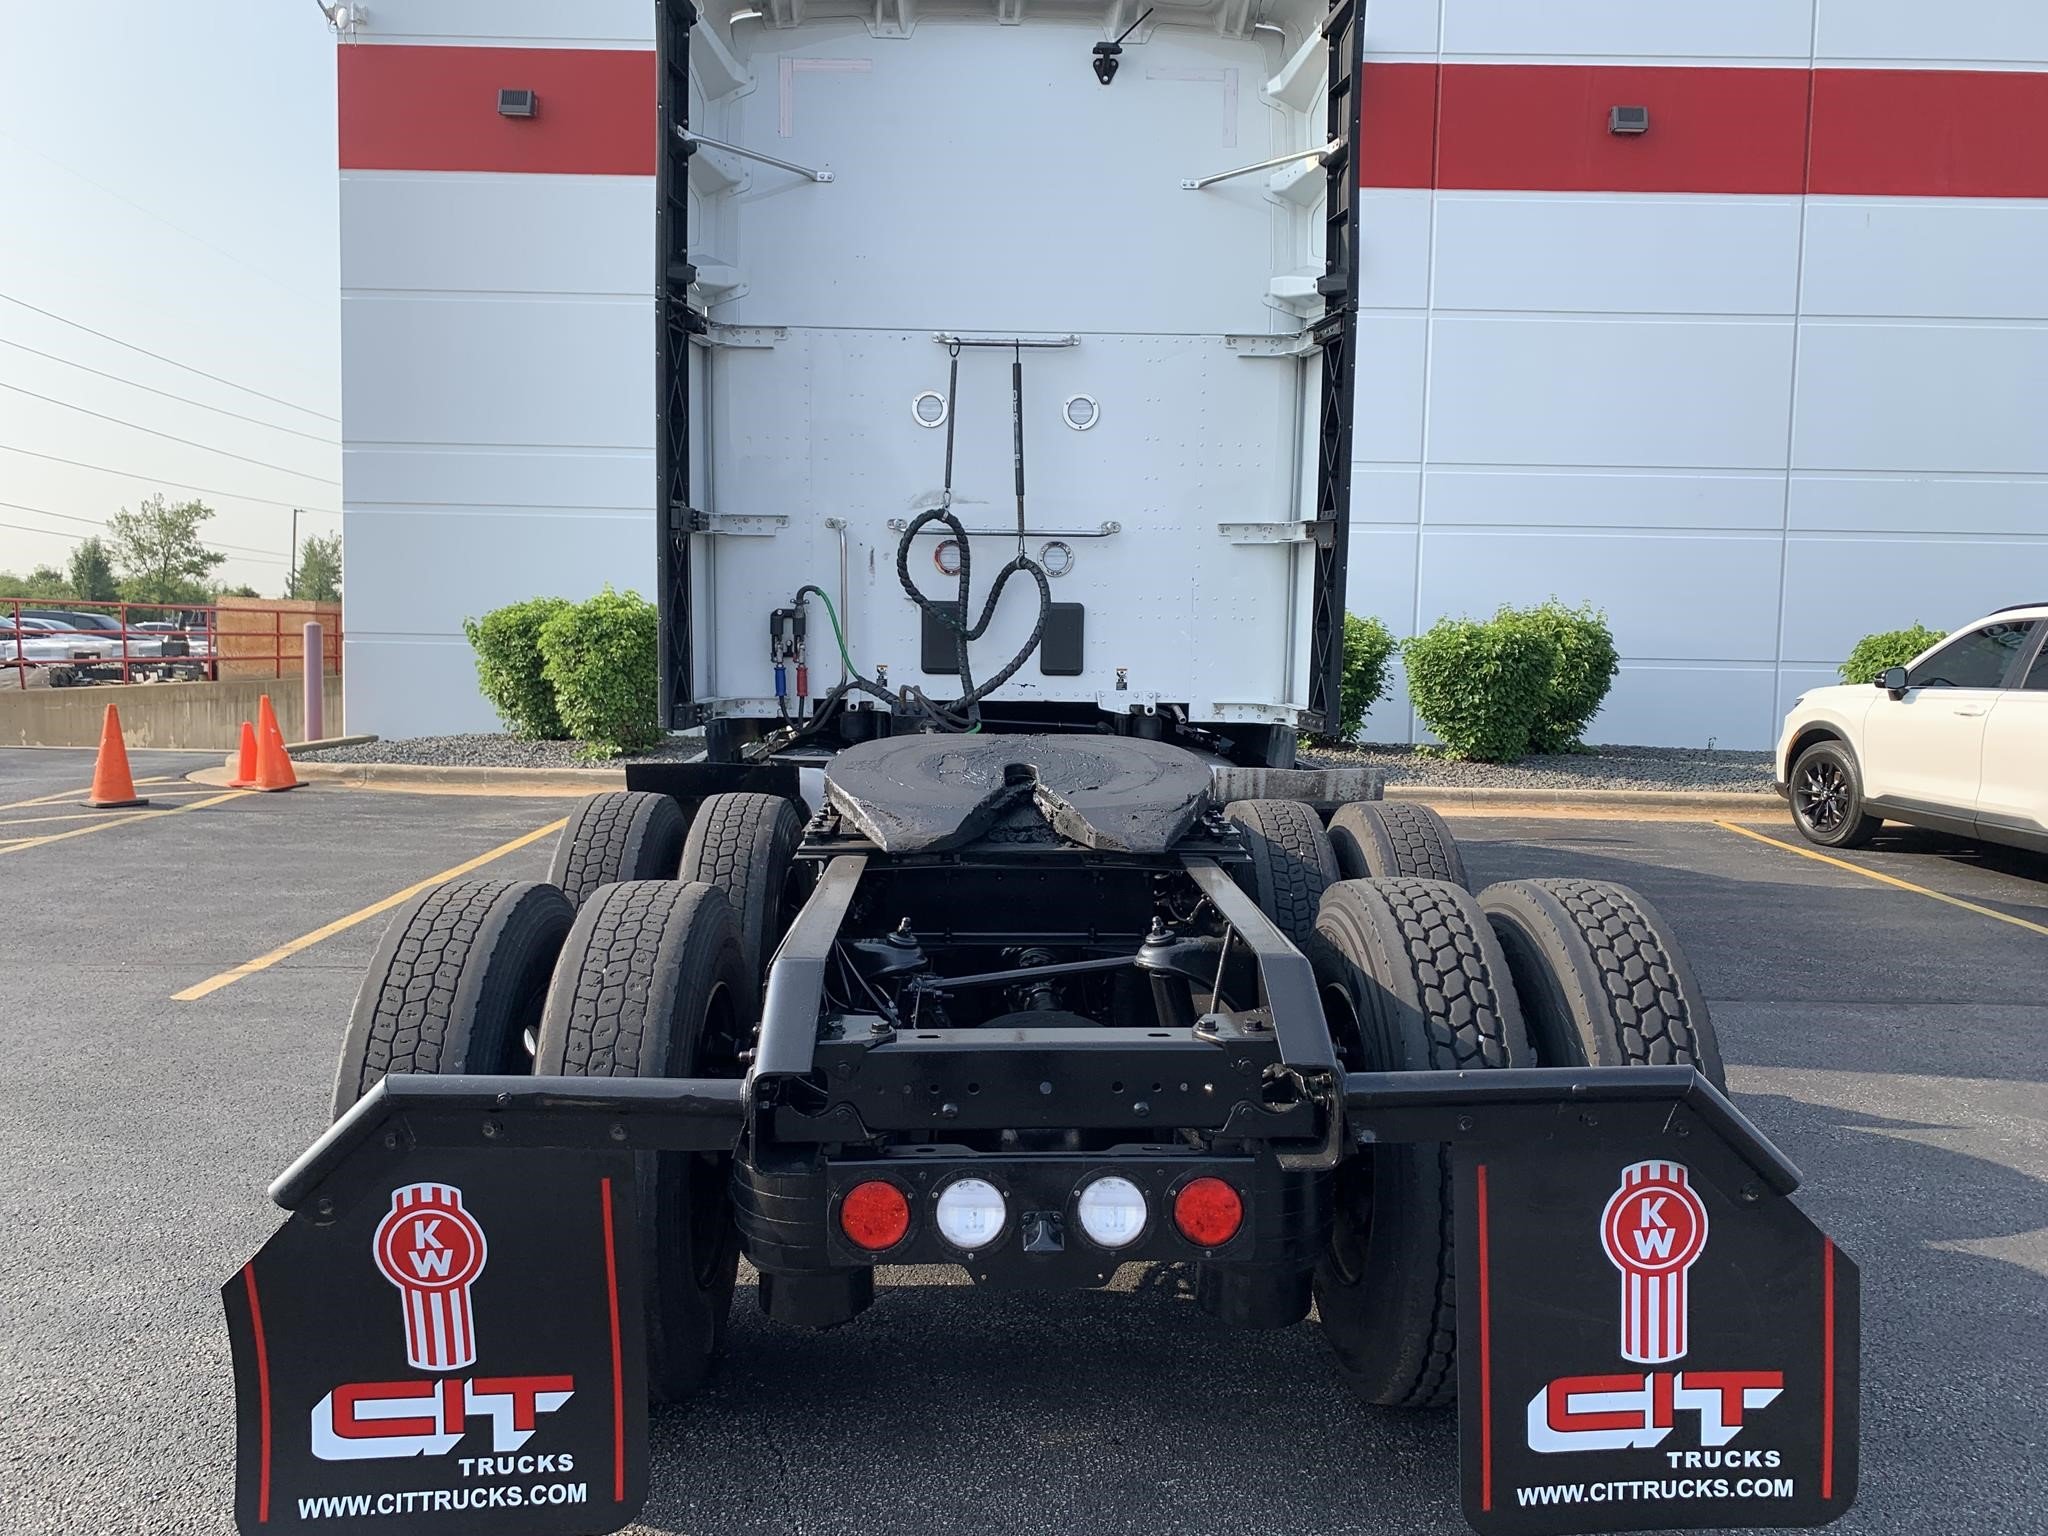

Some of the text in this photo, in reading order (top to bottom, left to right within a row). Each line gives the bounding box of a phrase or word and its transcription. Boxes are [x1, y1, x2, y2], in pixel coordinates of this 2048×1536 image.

[1641, 1198, 1667, 1227] K
[415, 1220, 443, 1249] K
[1633, 1228, 1674, 1259] W
[408, 1249, 453, 1278] W
[311, 1375, 575, 1461] CIT
[1527, 1371, 1784, 1453] CIT
[459, 1453, 574, 1477] TRUCKS
[1667, 1450, 1781, 1469] TRUCKS
[298, 1483, 587, 1519] WWW.CITTRUCKS.COM
[1517, 1479, 1794, 1506] WWW.CITTRUCKS.COM
